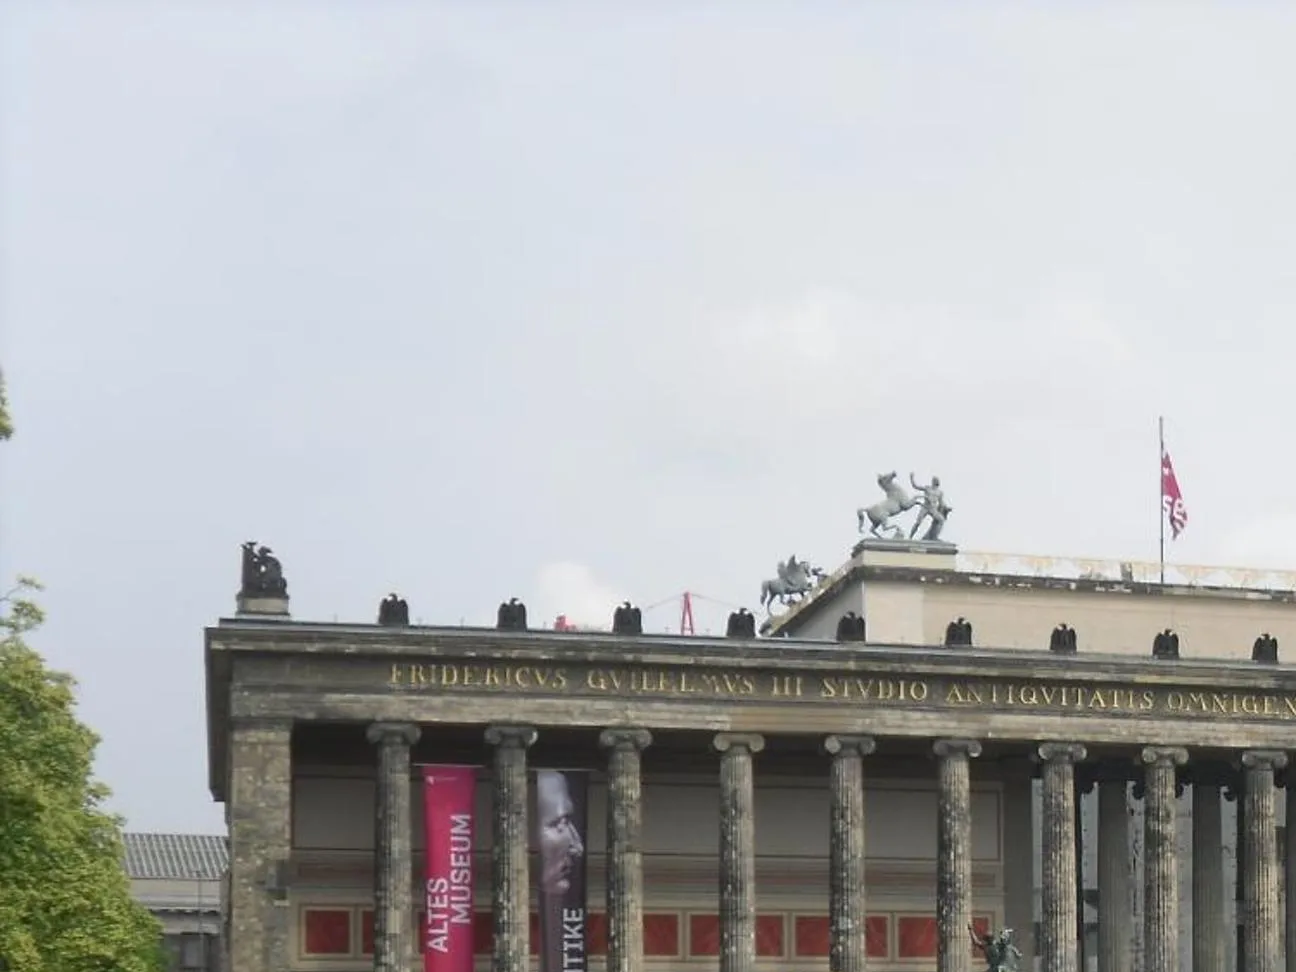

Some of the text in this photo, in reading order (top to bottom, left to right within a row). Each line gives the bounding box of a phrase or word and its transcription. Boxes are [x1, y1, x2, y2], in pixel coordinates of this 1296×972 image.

[391, 663, 566, 689] FRIDERICVS
[587, 669, 755, 697] GVILELMVS
[771, 675, 803, 696] III
[821, 677, 929, 701] STVDIO
[945, 682, 1155, 711] ANTIQVITATIS
[450, 813, 472, 925] MUSEUM
[426, 877, 449, 954] ALTES
